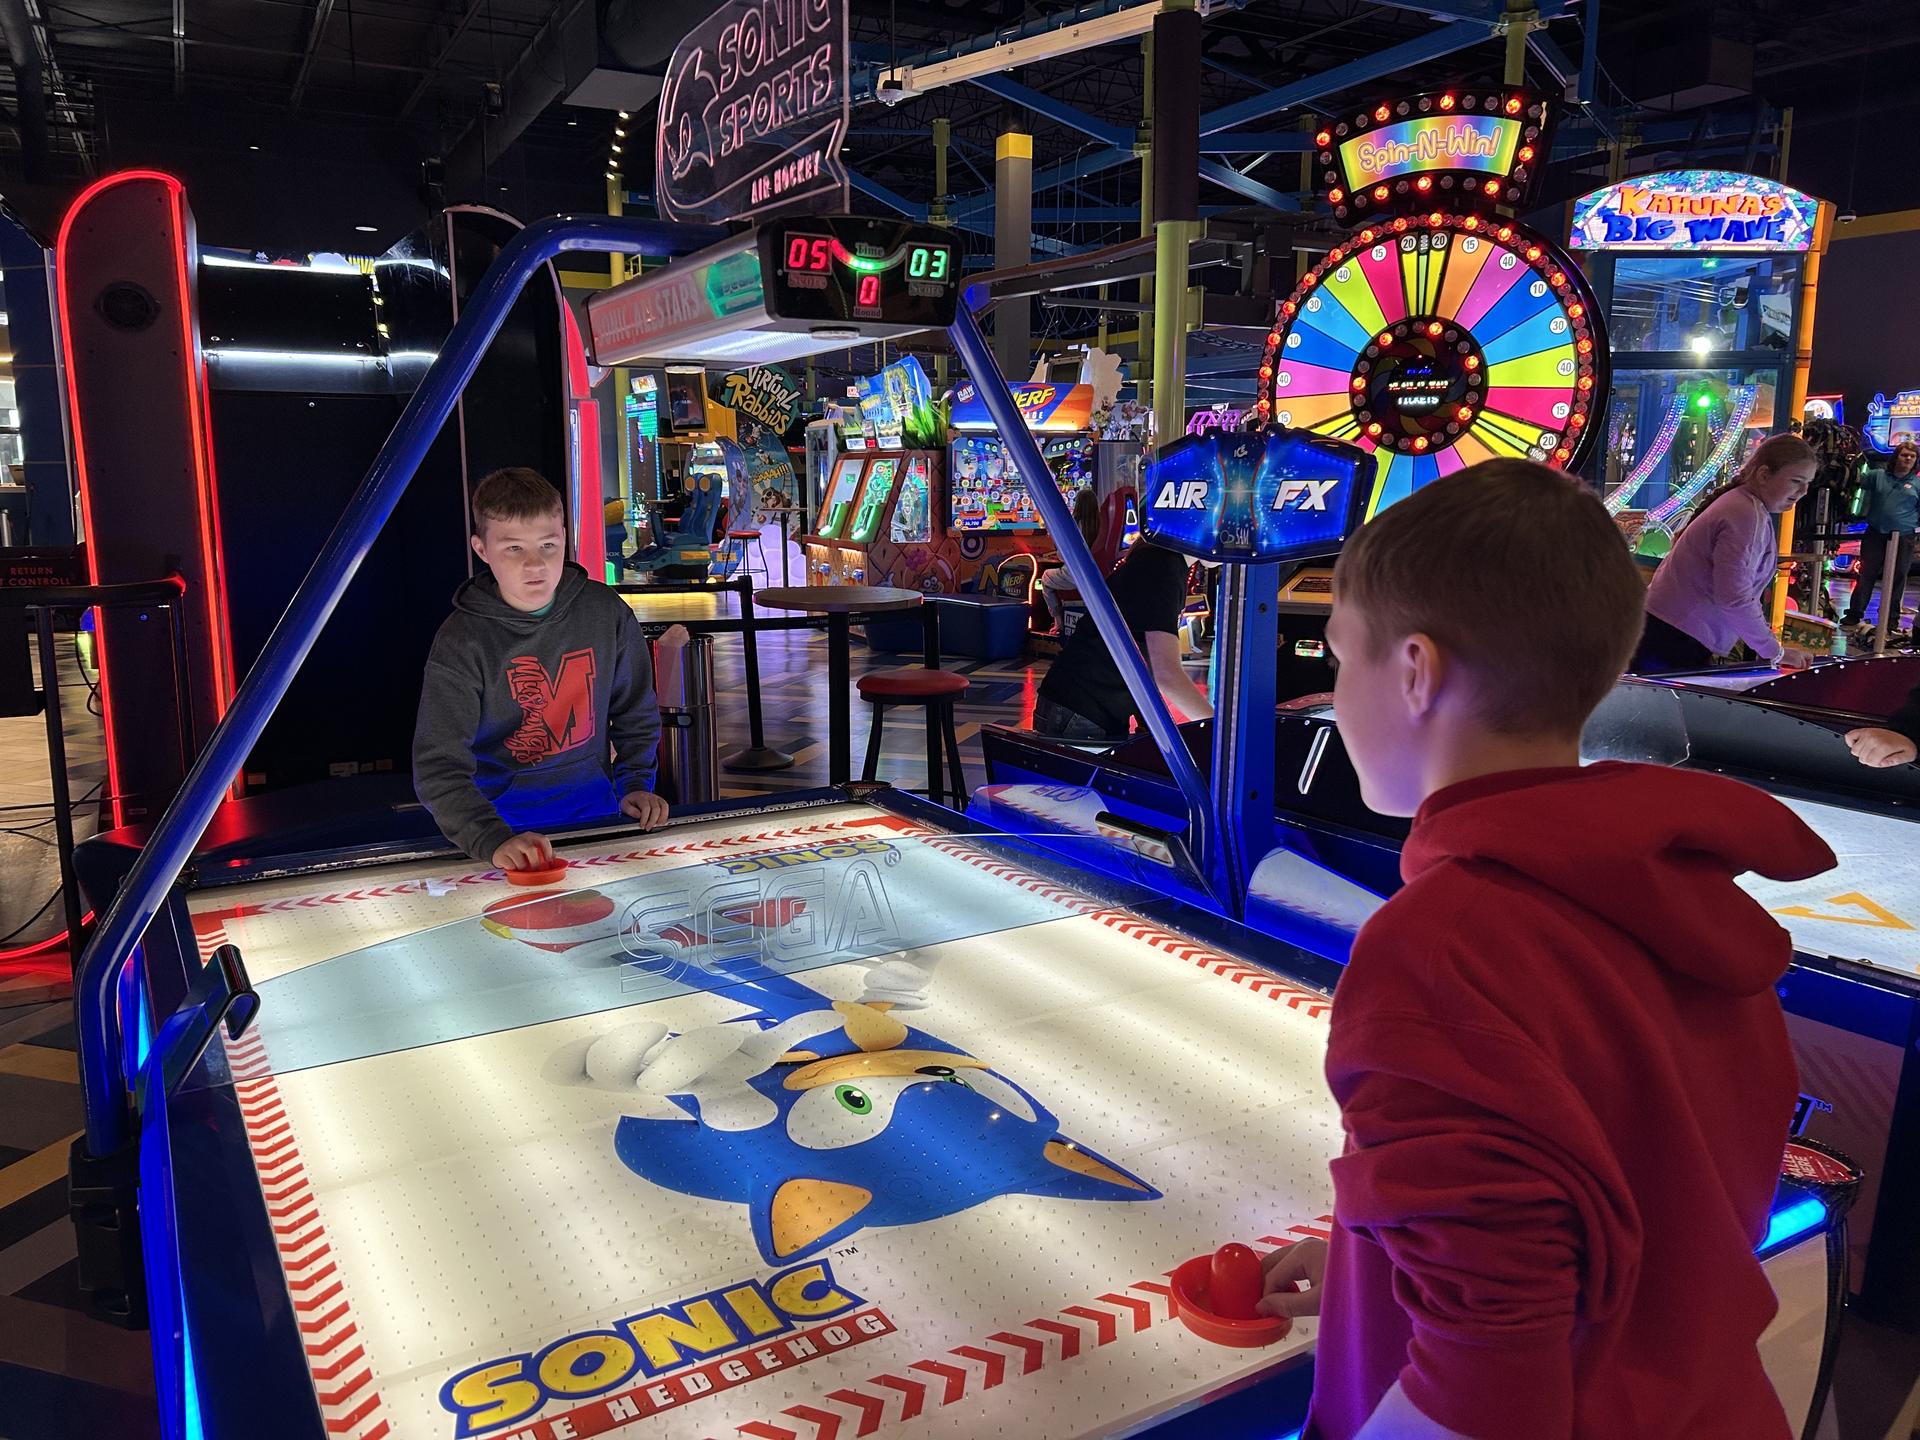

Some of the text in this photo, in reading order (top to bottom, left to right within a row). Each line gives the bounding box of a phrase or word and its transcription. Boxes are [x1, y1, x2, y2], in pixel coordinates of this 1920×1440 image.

[718, 0, 832, 94] SONIC
[719, 43, 833, 157] SPORTS
[1357, 123, 1503, 175] Spin-N-Win!
[751, 150, 821, 205] AIR HOCKEY
[1619, 186, 1784, 217] KAHUNA'S
[1602, 214, 1787, 244] BIG WAVE
[788, 238, 828, 270] 05
[909, 248, 948, 278] 03
[1530, 447, 1547, 462] 1000
[1153, 479, 1340, 512] AIR FX
[10, 567, 53, 576] RETURN
[716, 839, 897, 876] SONIC
[617, 858, 902, 994] SEGA
[438, 1258, 869, 1440] SONIC
[605, 1313, 887, 1422] HEDGEHOG
